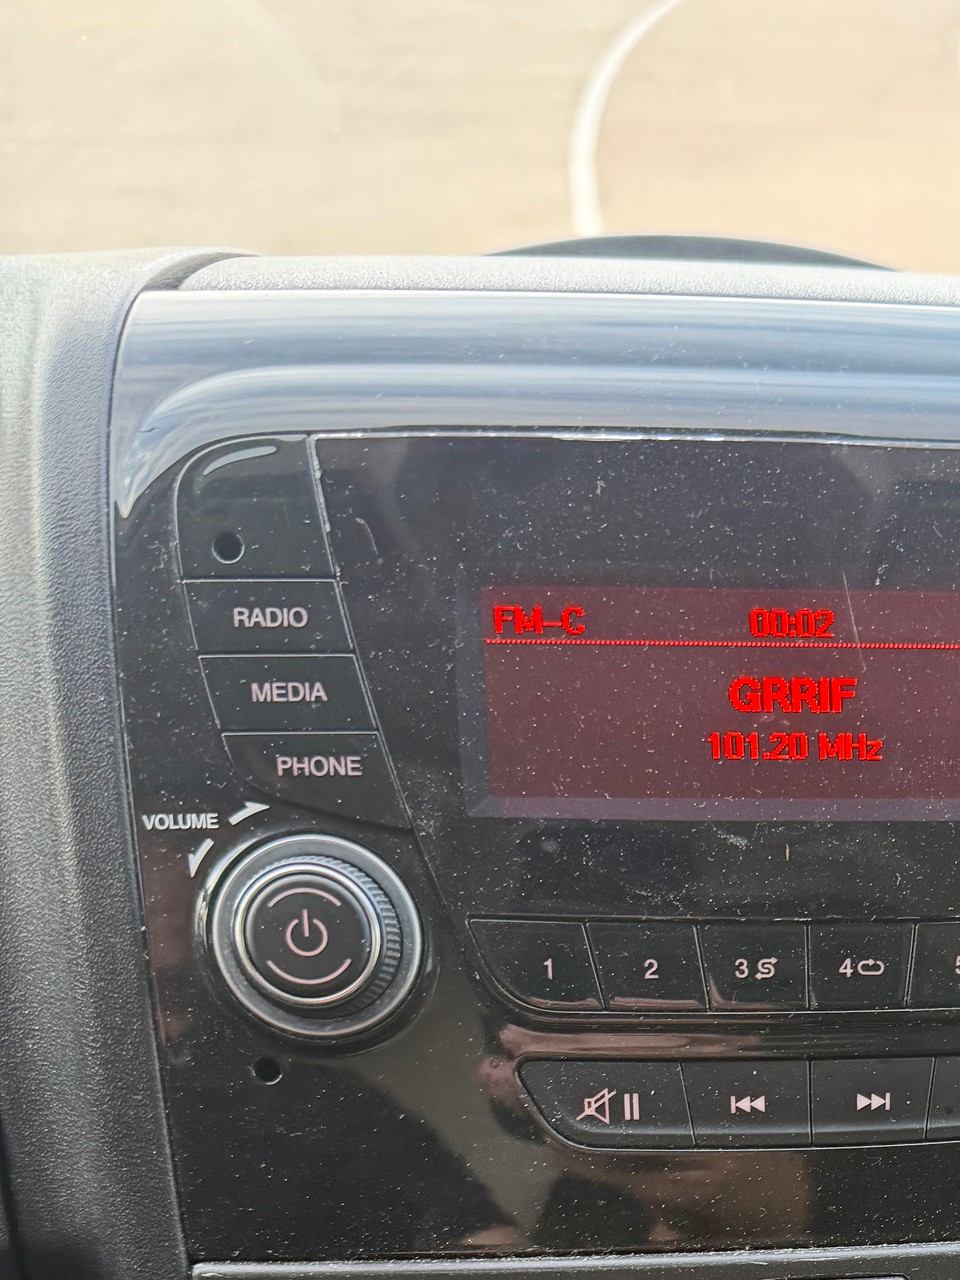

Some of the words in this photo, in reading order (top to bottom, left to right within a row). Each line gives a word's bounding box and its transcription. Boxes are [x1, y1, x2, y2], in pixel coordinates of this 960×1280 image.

[232, 607, 308, 629] RADIO
[492, 605, 586, 635] FM-C
[748, 608, 836, 639] 00:02
[250, 682, 328, 702] MEDIA
[727, 676, 859, 714] GRRIF
[706, 731, 808, 762] 101.20
[817, 733, 884, 762] MHz
[275, 756, 363, 777] PHONE
[142, 812, 219, 831] VOLUME
[543, 959, 554, 981] 1
[642, 958, 660, 981] 2
[734, 958, 749, 979] 3
[838, 957, 854, 979] 4
